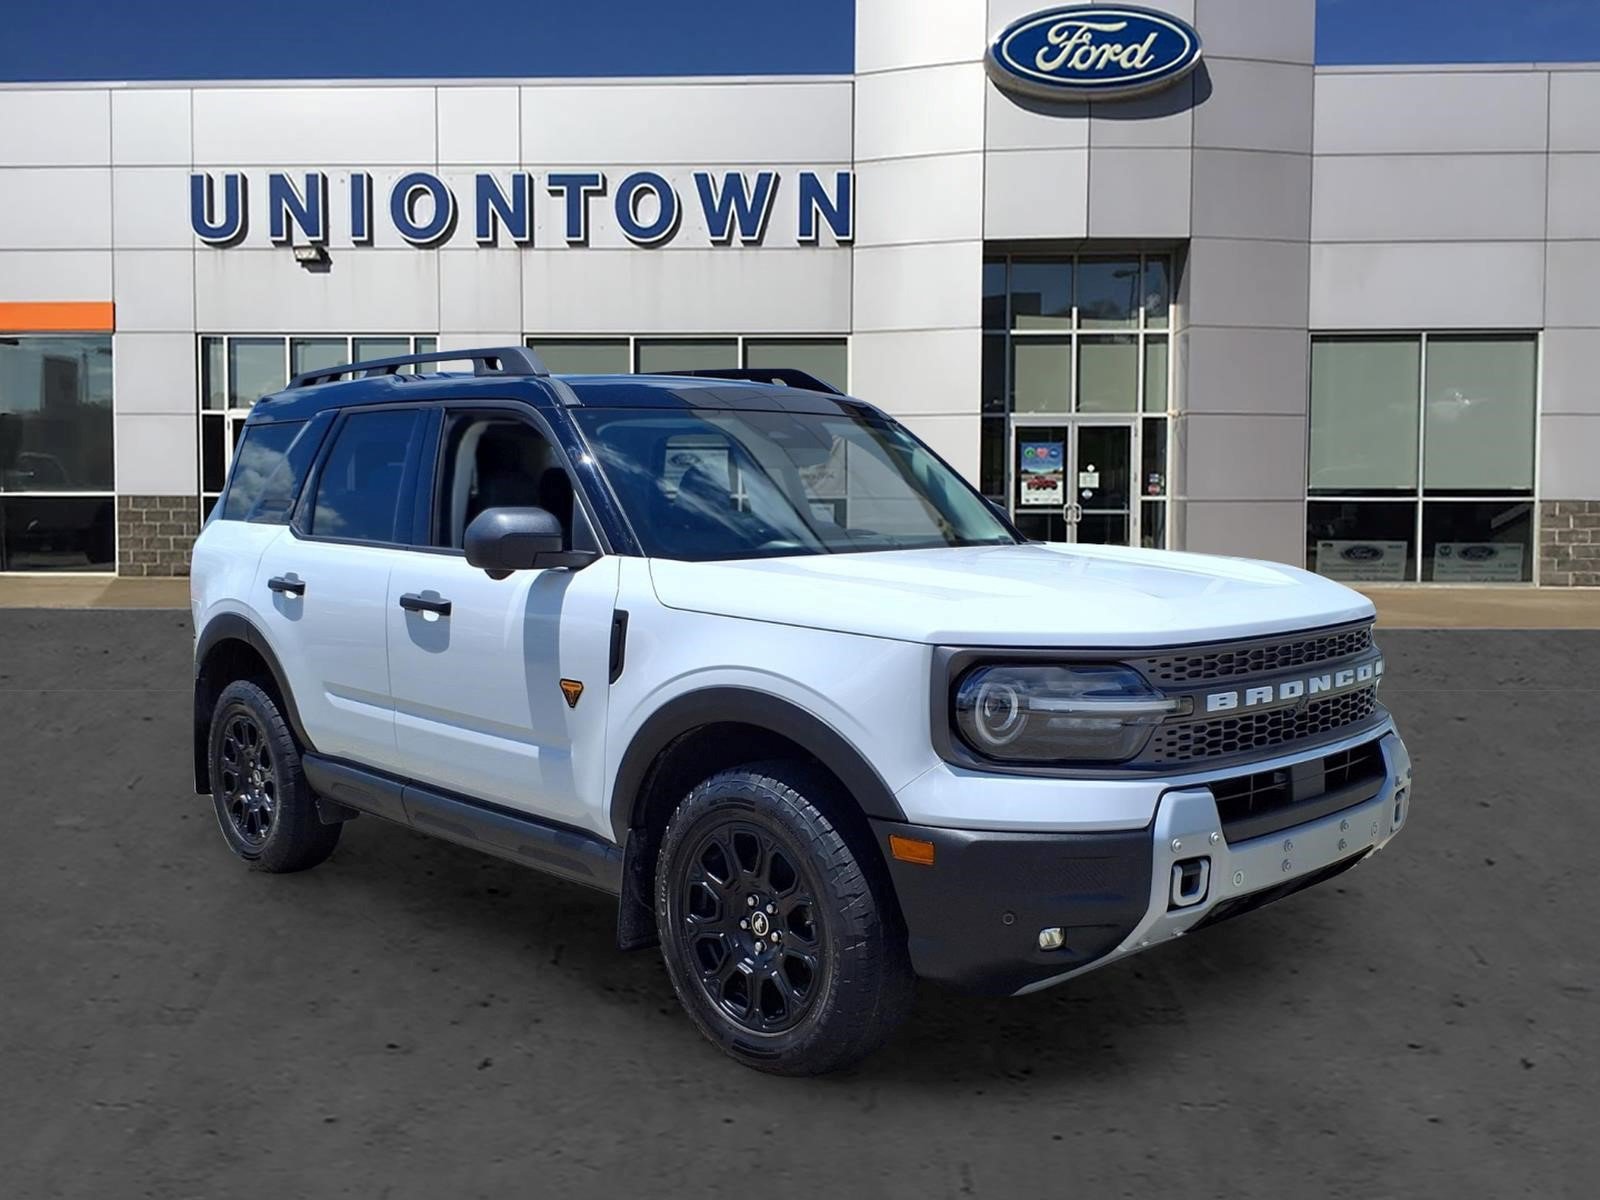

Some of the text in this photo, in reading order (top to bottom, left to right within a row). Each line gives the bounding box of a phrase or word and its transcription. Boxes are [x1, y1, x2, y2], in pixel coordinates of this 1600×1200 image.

[1035, 20, 1158, 72] Ford
[190, 171, 853, 246] UNIONTOWN
[1206, 664, 1373, 712] BRONCO
